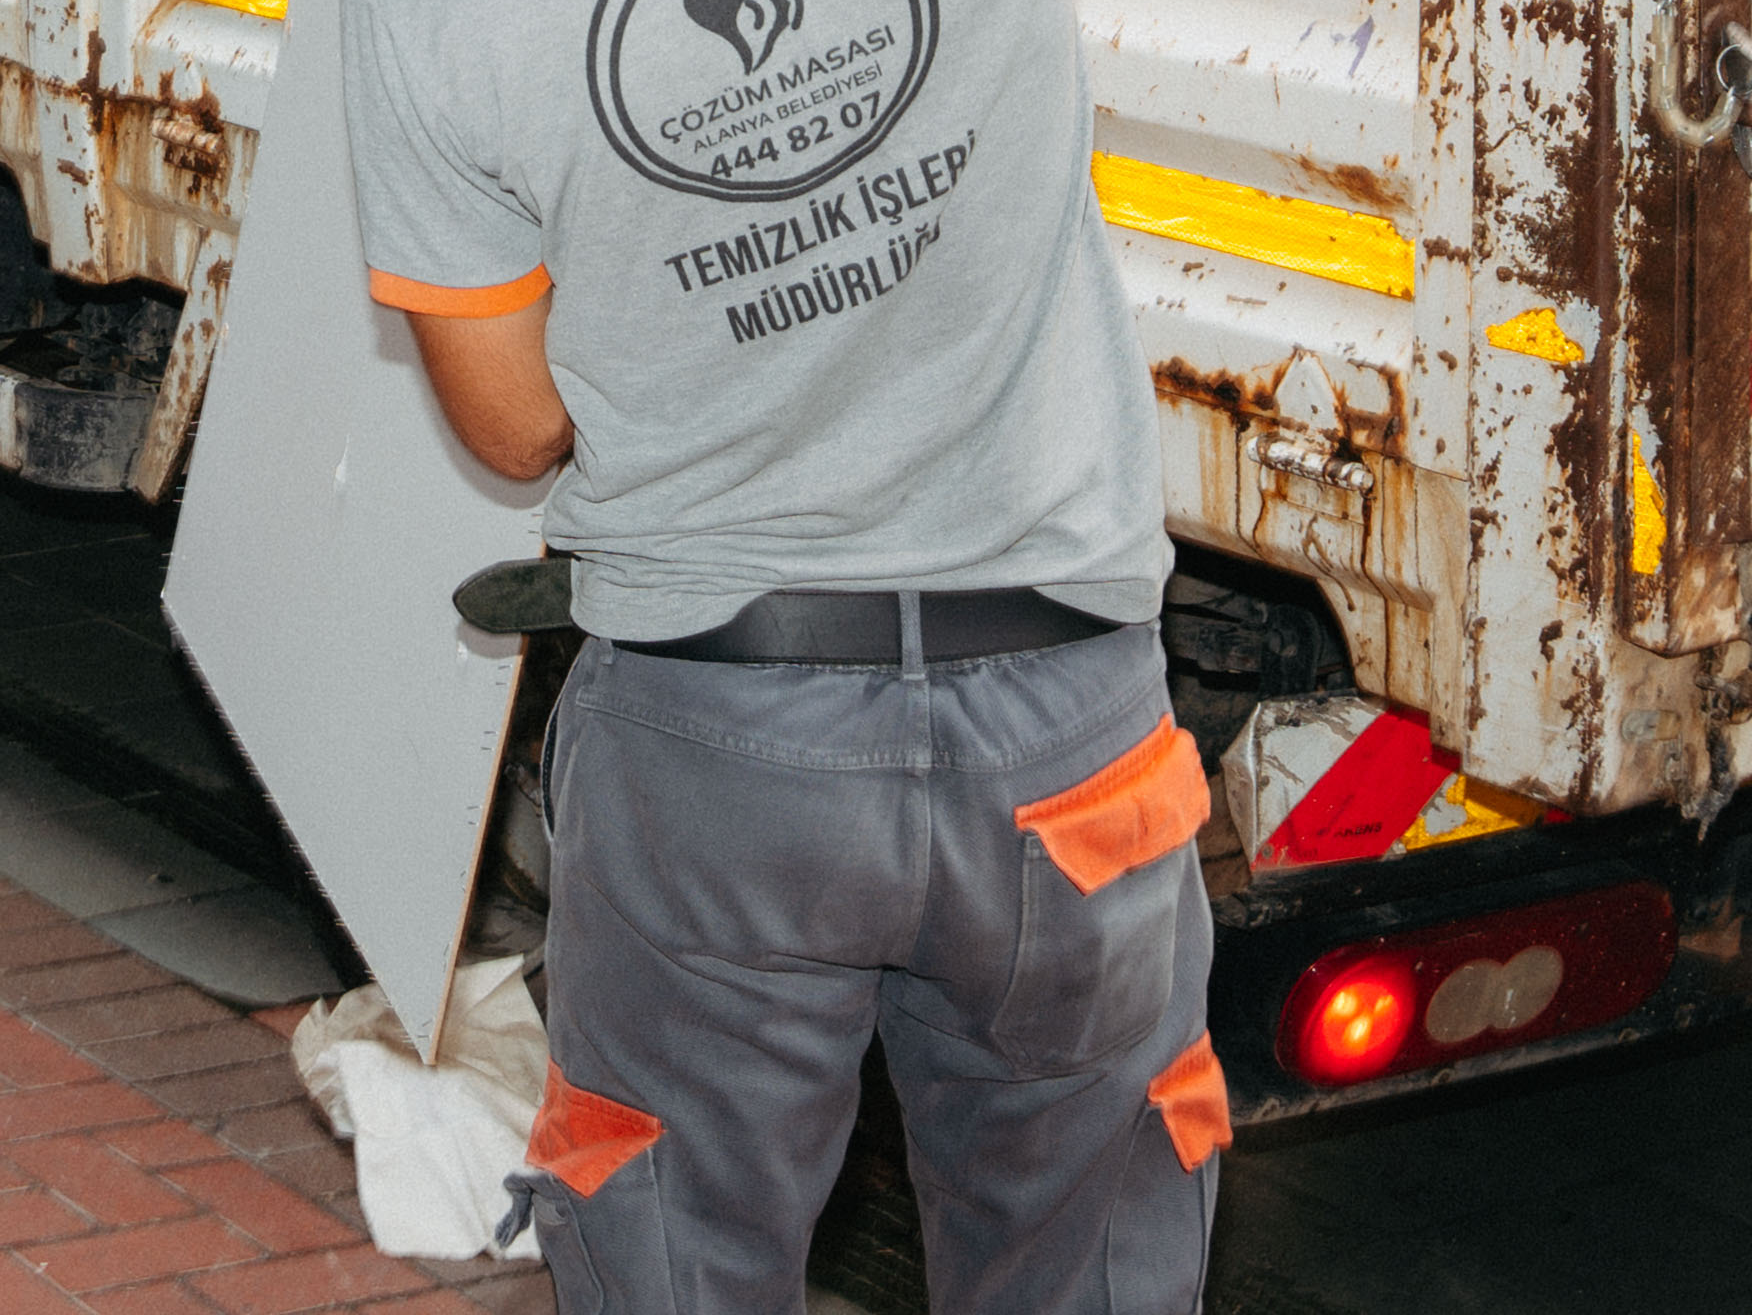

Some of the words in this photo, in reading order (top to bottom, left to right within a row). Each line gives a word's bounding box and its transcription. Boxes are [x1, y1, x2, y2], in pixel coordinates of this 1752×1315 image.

[660, 79, 773, 144] ÇÖZÜM
[776, 24, 896, 93] MASASI
[693, 114, 774, 154] ALANYA
[776, 59, 884, 121] BELEDİYESİ
[711, 136, 780, 178] 444
[786, 114, 835, 153] 82
[839, 90, 882, 129] 07
[664, 192, 857, 293] TEMİZLİK
